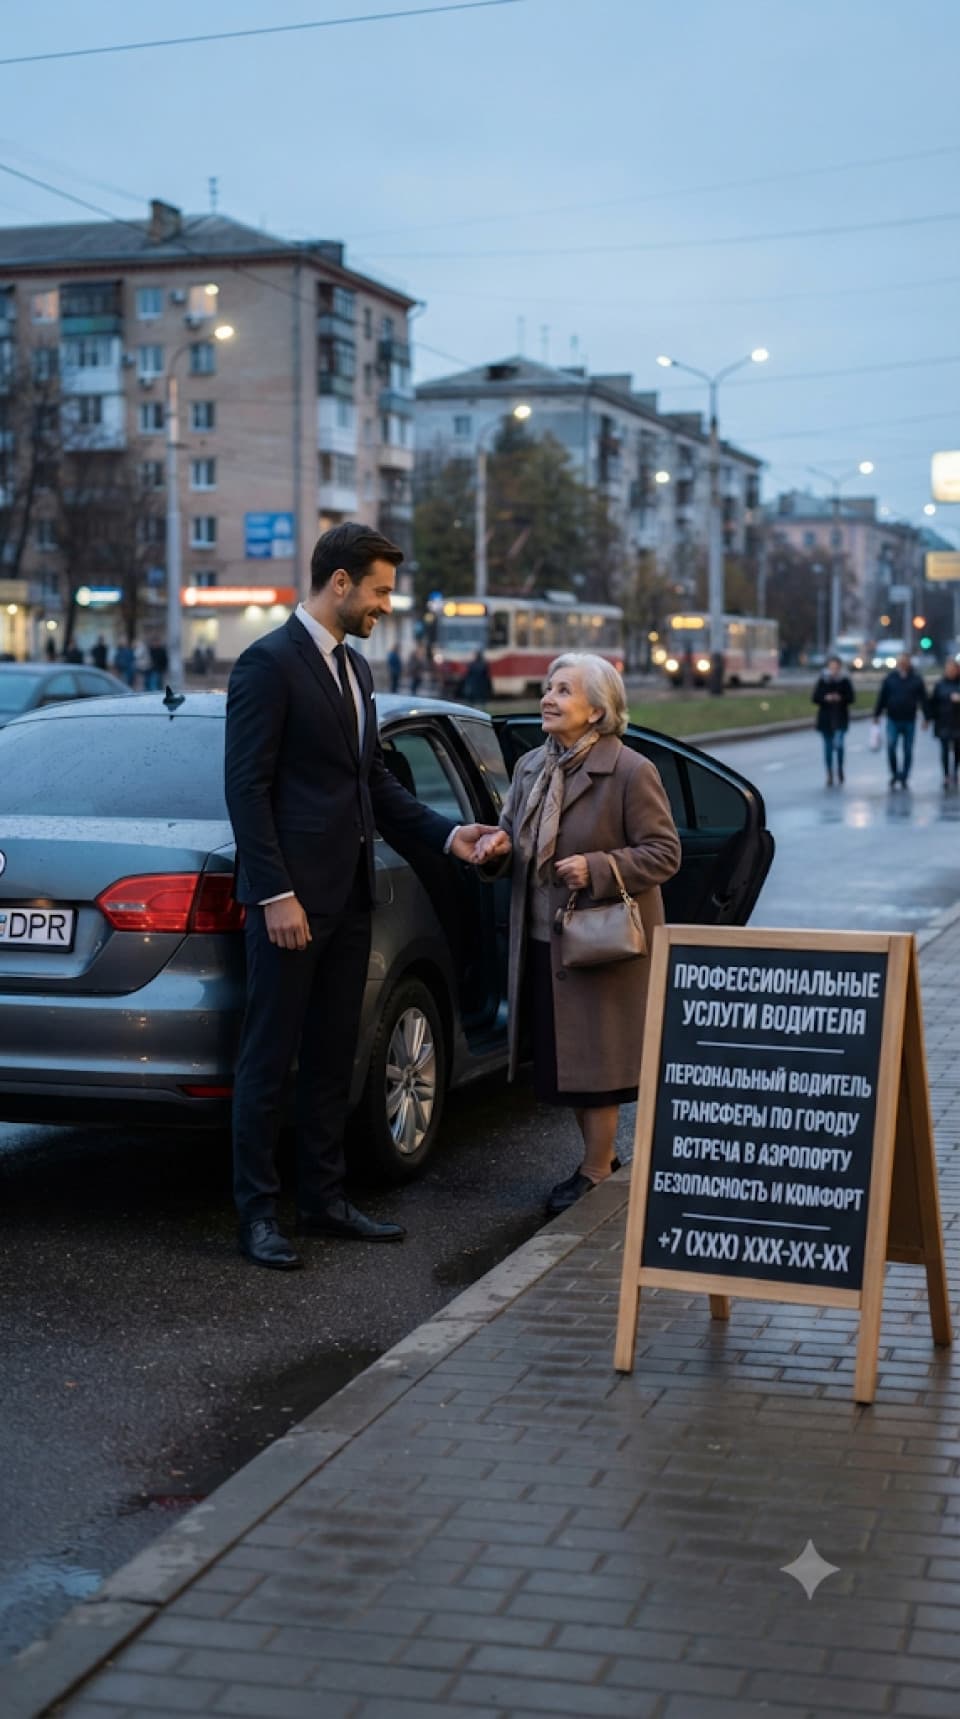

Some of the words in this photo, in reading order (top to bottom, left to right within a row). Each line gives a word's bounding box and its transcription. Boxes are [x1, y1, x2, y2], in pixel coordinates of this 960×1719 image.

[9, 912, 66, 940] DPR
[674, 964, 880, 998] ПРОФЕССИОНАЛЬНЫЕ
[682, 1000, 757, 1029] УСЛУГИ
[761, 1004, 866, 1035] ВОДИТЕЛЯ
[665, 1063, 786, 1093] ПЕРСОНАЛЬНЫЙ
[789, 1071, 871, 1099] ВОДИТЕЛЬ
[671, 1099, 767, 1128] ТРАНСФЕРЫ
[770, 1107, 792, 1130] ПО
[795, 1108, 859, 1137] ГОРОДУ
[673, 1136, 740, 1164] ВСТРЕЧА
[744, 1142, 755, 1164] В
[757, 1143, 852, 1172] АЭРОПОРТУ
[654, 1171, 767, 1202] БЕЗОПАСНОСТЬ
[770, 1182, 782, 1204] И
[785, 1183, 863, 1211] КОМФОРТ
[658, 1228, 682, 1254] +7
